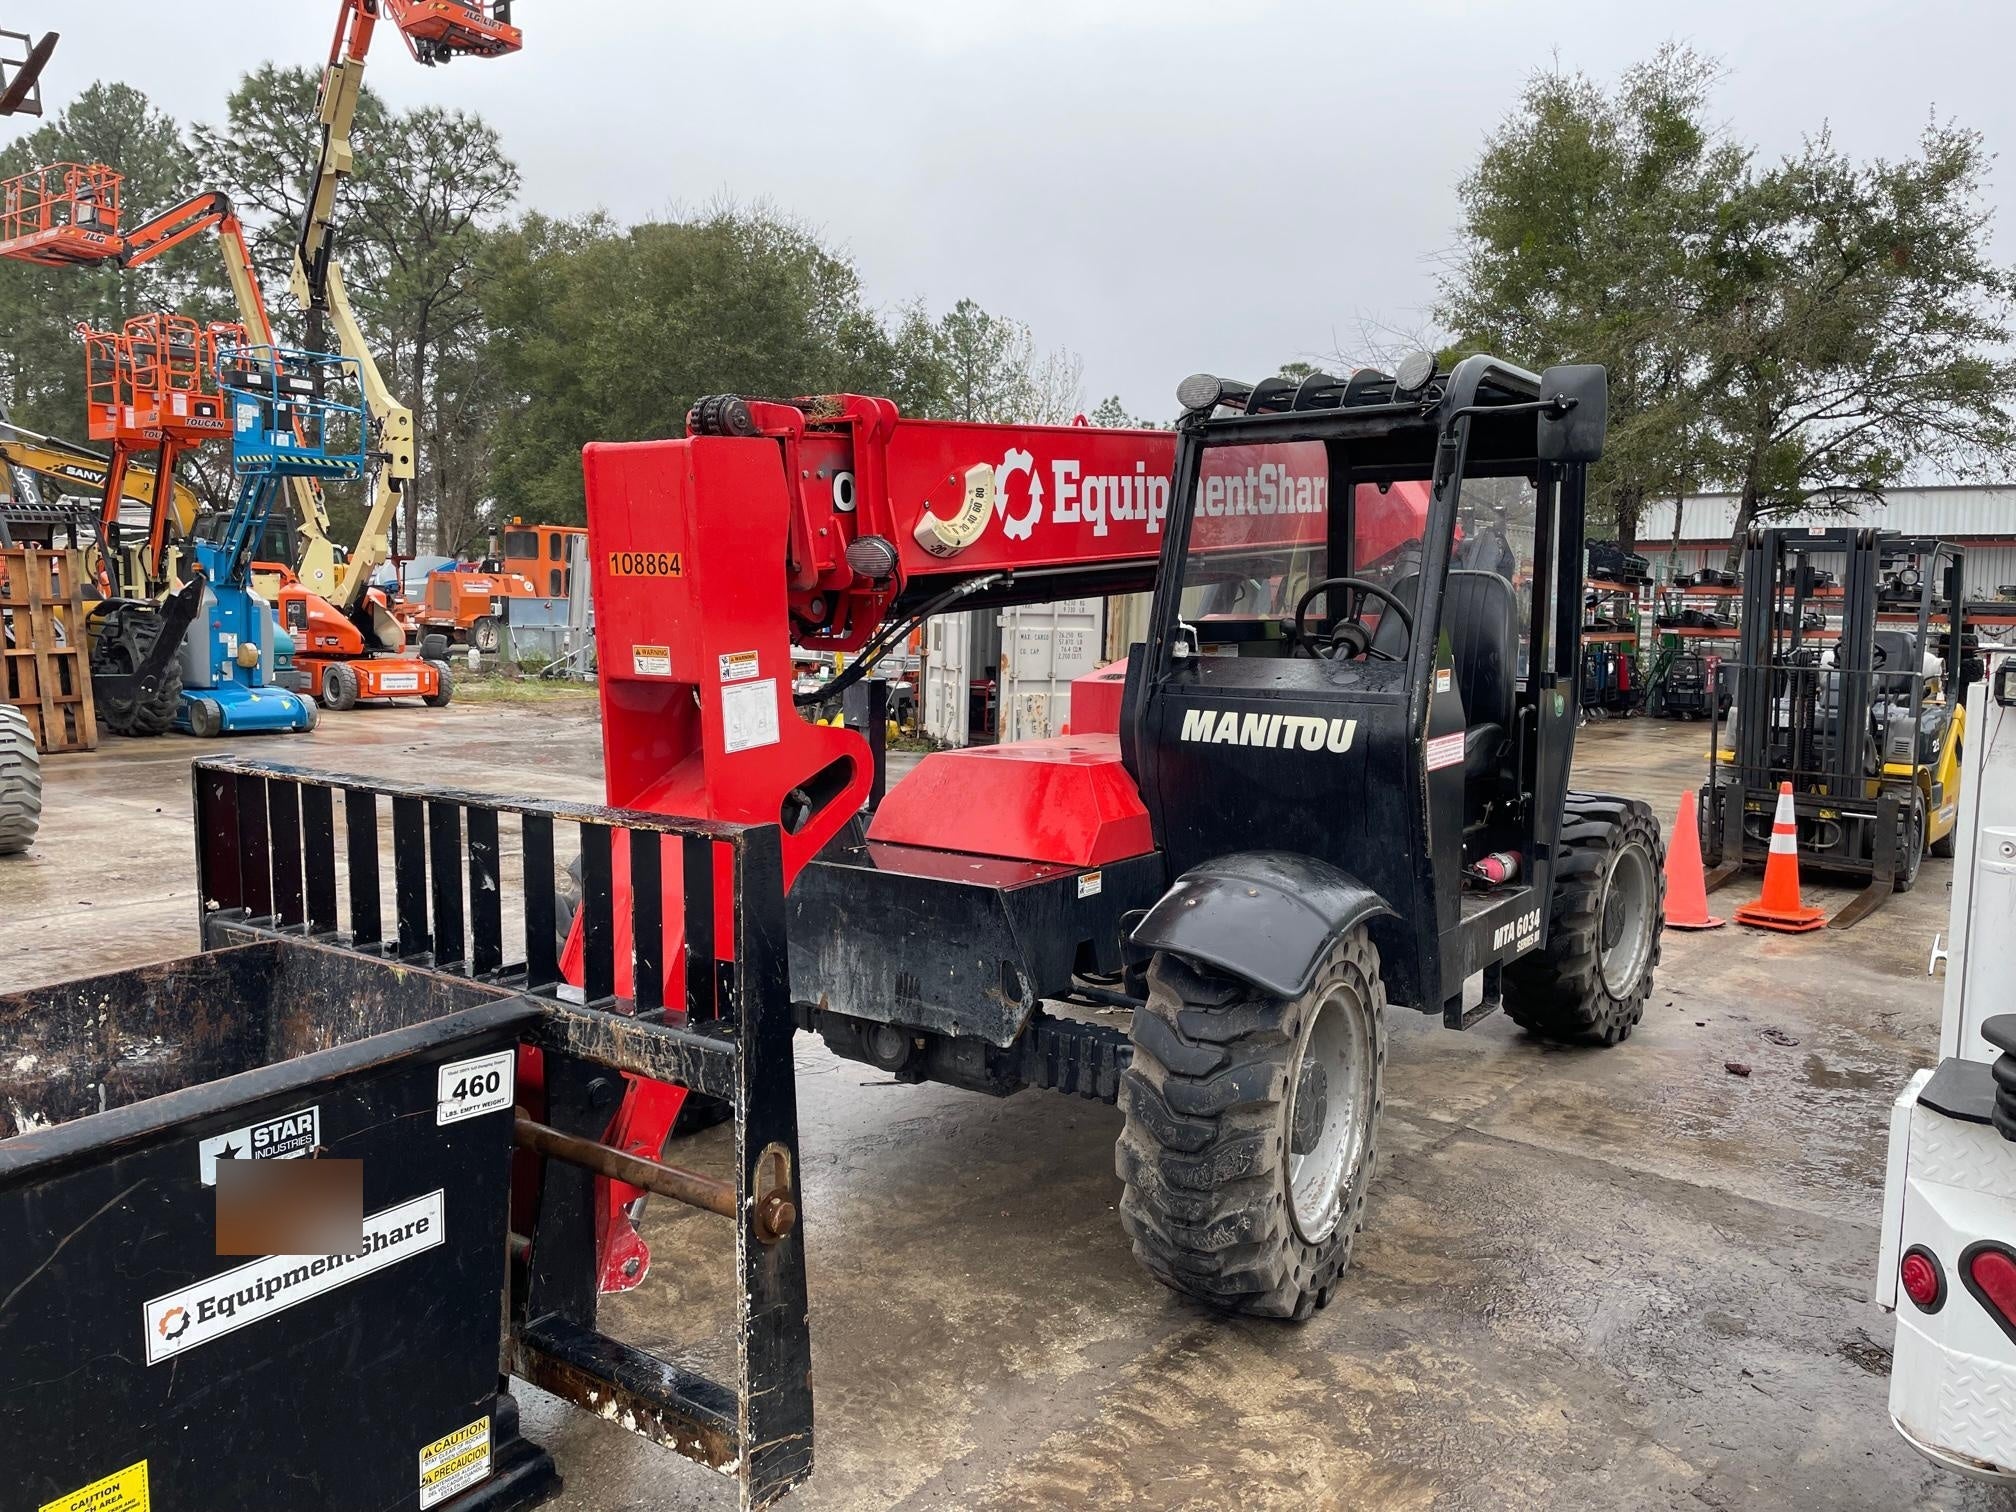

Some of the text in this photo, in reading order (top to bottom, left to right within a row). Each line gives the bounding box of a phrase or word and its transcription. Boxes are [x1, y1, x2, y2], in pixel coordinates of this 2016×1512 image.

[464, 11, 503, 30] JLG LIFT
[83, 232, 105, 243] JLG
[186, 419, 224, 428] TOUCAN
[66, 466, 102, 482] SANY
[975, 488, 984, 498] 80
[1052, 460, 1328, 536] EquipentShar
[972, 502, 982, 513] 60
[967, 515, 977, 524] 40
[611, 553, 681, 575] 108864
[1181, 709, 1357, 753] MANITOU
[1493, 908, 1540, 950] MTA 6034
[452, 1071, 500, 1100] 460
[461, 1104, 480, 1113] EMPTY
[482, 1098, 505, 1107] WEIGHT
[254, 1114, 312, 1147] STAR
[255, 1134, 312, 1159] INDUSTRIES
[434, 1420, 486, 1453] CAUTION
[425, 1456, 437, 1466] STAY
[438, 1448, 455, 1460] CLEAR
[434, 1446, 486, 1480] PRECAUCION
[70, 1483, 120, 1511] CAUTION
[99, 1494, 123, 1509] AREA
